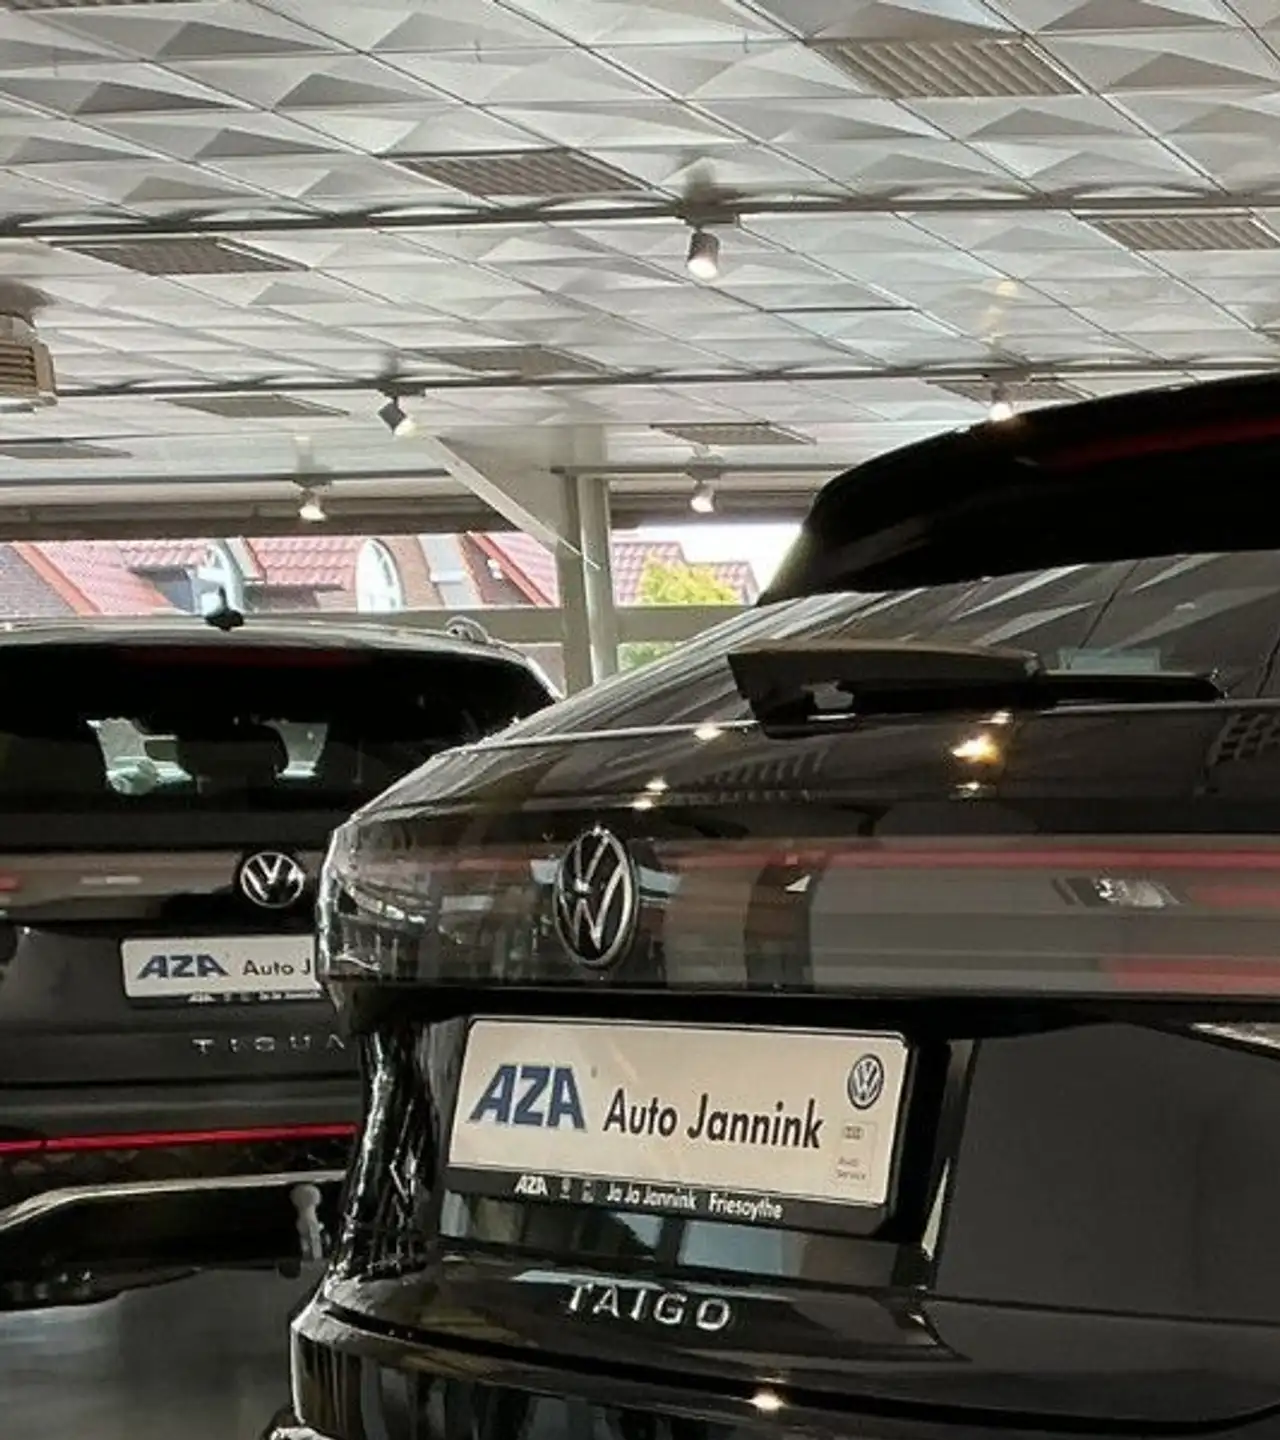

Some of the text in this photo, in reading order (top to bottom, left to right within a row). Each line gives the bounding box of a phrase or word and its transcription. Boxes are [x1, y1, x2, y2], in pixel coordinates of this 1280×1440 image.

[137, 955, 230, 979] AZA
[242, 959, 294, 976] Auto
[467, 1064, 824, 1150] AZA Auto Jannink
[513, 1174, 549, 1197] AZA
[568, 1282, 731, 1332] TAIGO
